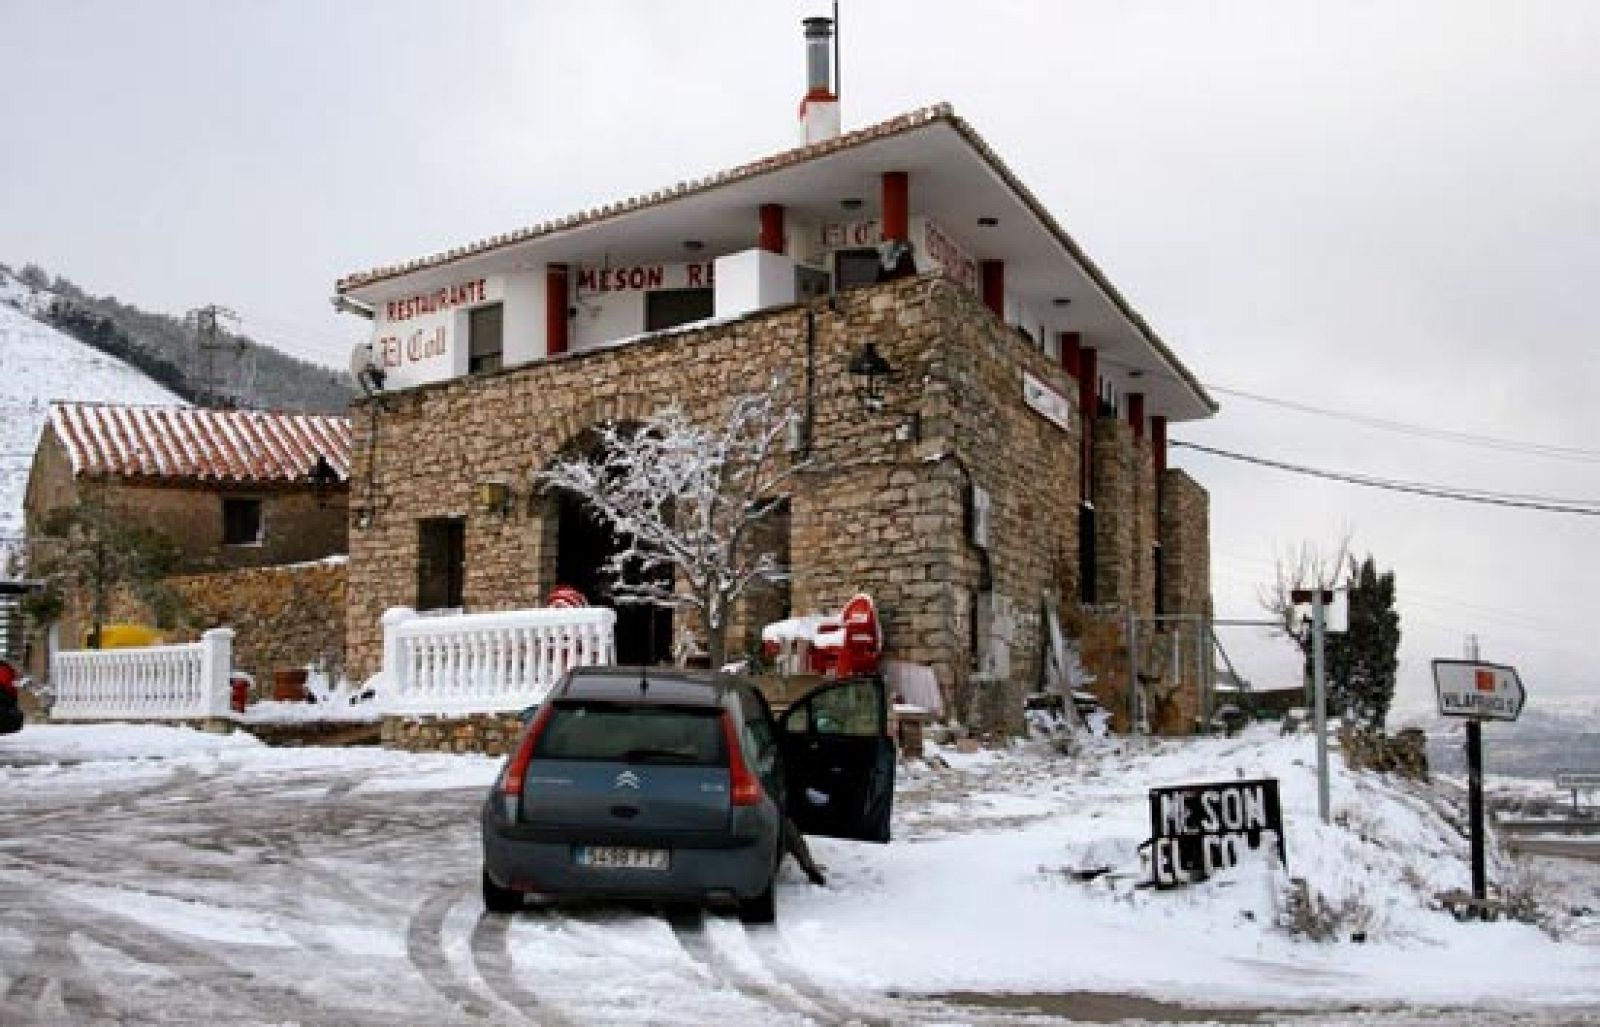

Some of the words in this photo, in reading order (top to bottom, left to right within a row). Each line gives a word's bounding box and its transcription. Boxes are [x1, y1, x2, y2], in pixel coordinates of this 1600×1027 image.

[386, 278, 487, 322] RESTAURANTE
[577, 264, 664, 292] MESON
[1157, 837, 1191, 883] EL
